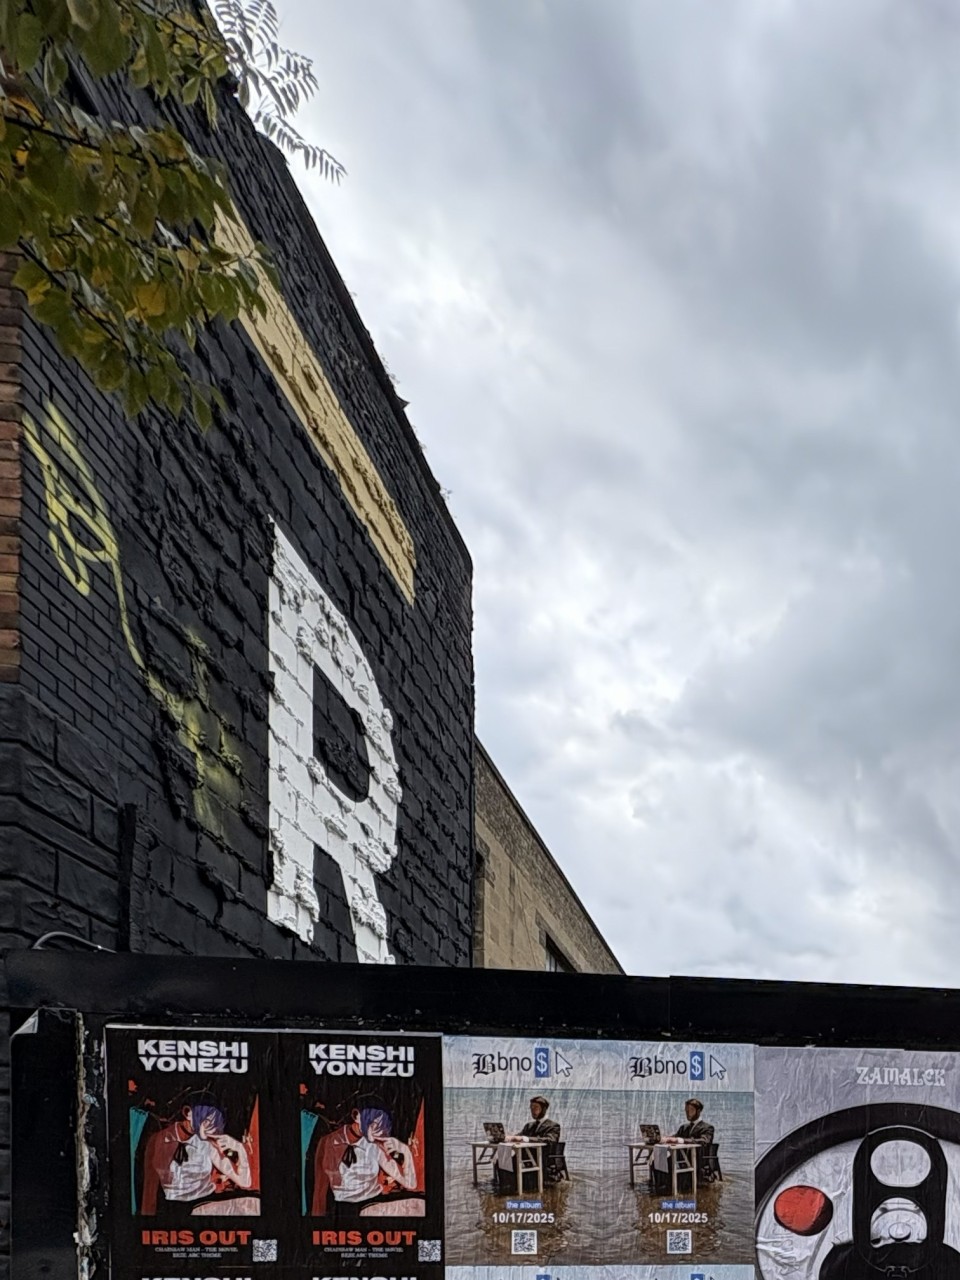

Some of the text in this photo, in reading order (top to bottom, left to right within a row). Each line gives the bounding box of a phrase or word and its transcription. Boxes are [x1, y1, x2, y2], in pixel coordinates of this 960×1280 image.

[138, 1039, 249, 1058] KENSHI
[308, 1043, 415, 1062] KENSHI
[139, 1057, 249, 1074] YONEZU
[310, 1060, 415, 1078] YONEZU
[855, 1066, 946, 1086] ZAMALEK
[506, 1201, 542, 1209] the album
[661, 1201, 696, 1209] the album
[492, 1212, 555, 1224] 10/17/2025
[648, 1212, 708, 1223] 10/17/2025
[141, 1230, 252, 1245] IRIS OUT
[312, 1230, 417, 1246] IRIS OUT
